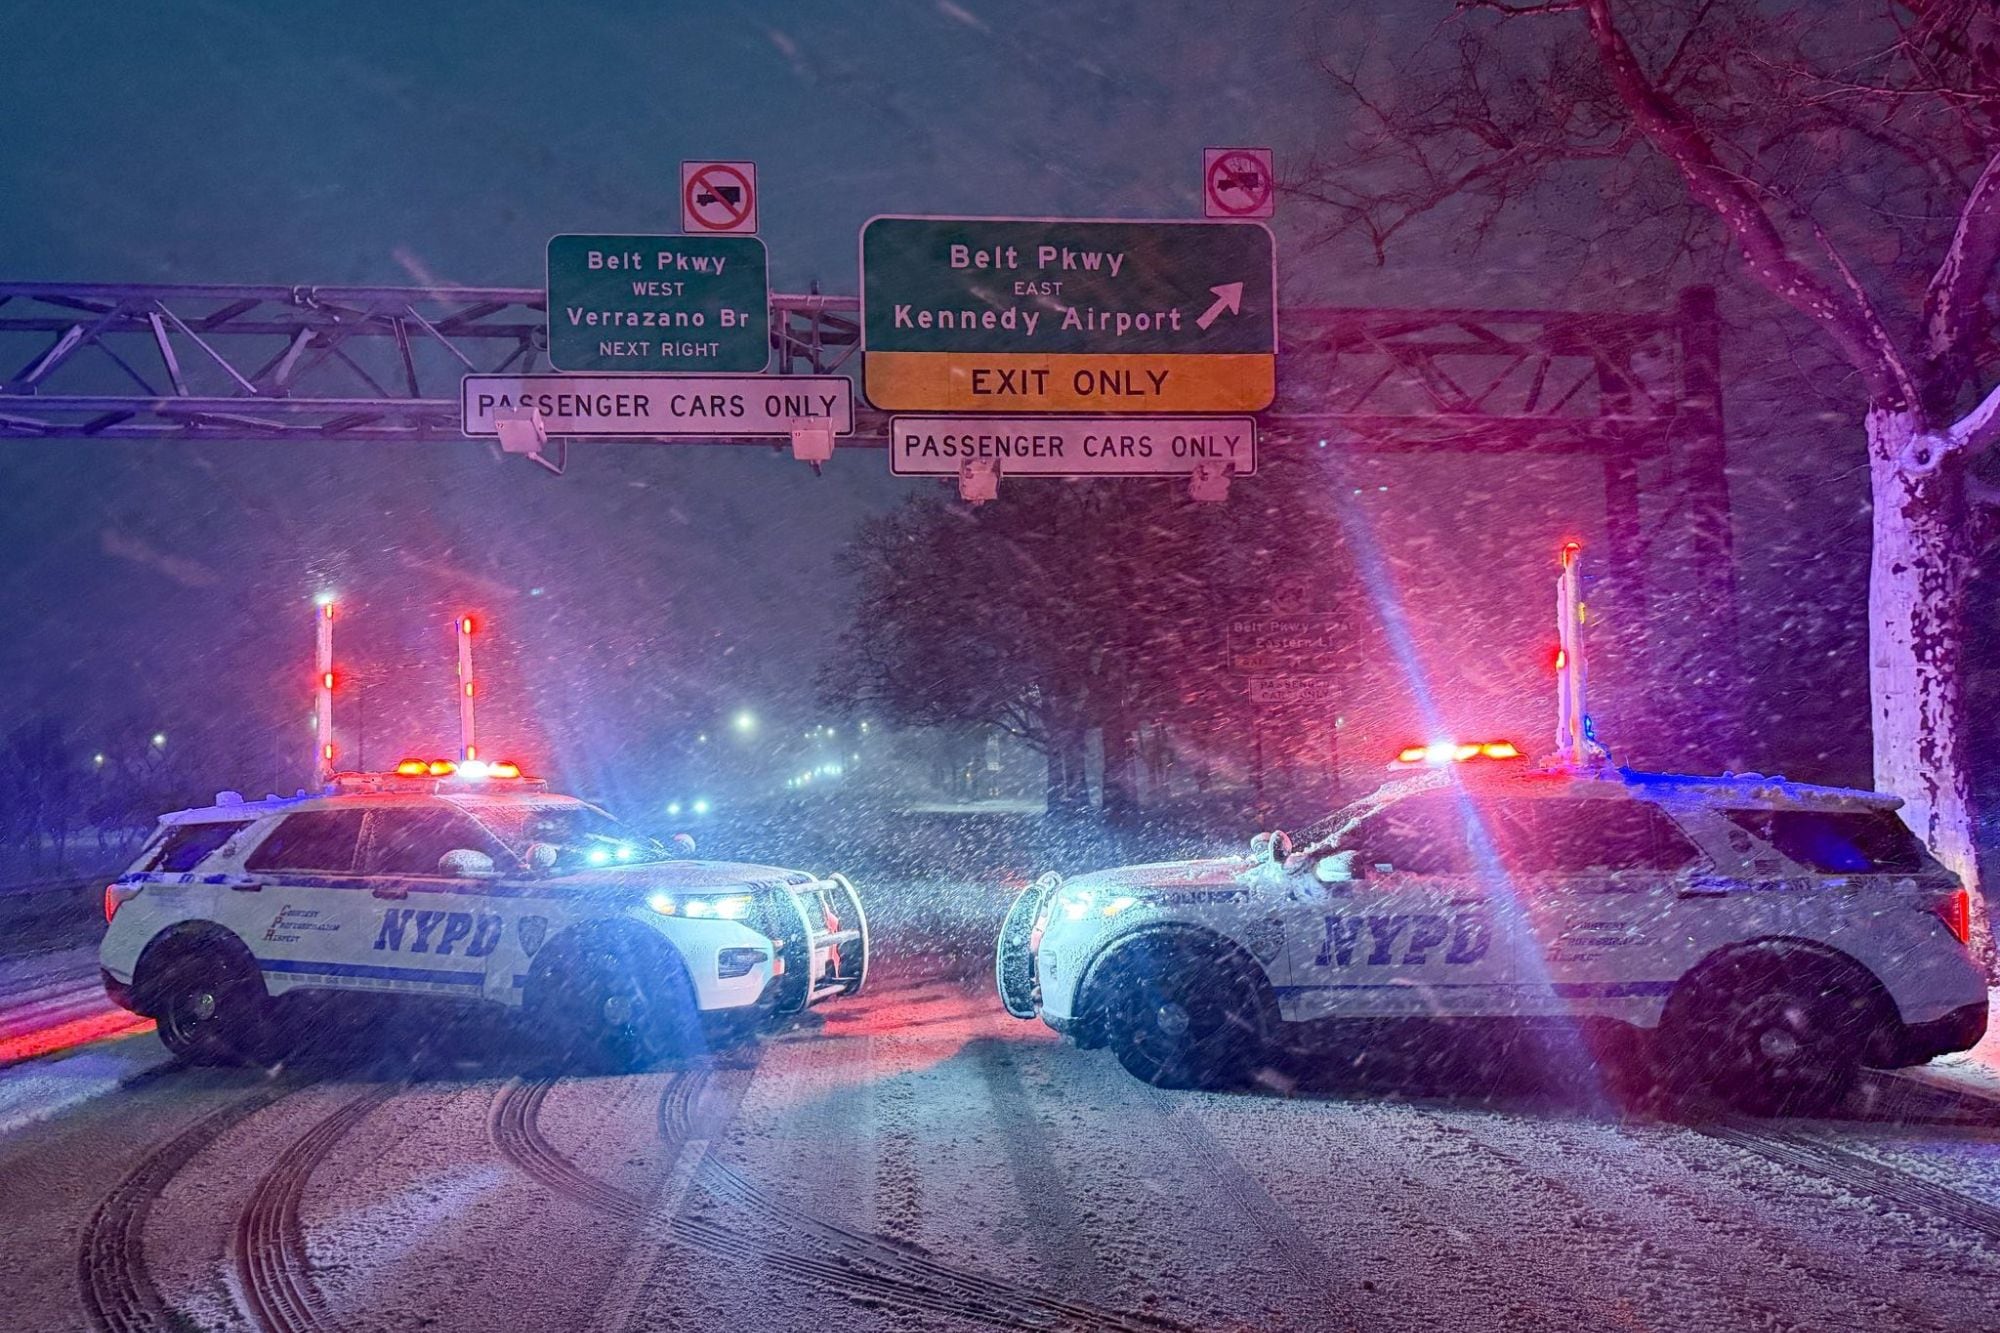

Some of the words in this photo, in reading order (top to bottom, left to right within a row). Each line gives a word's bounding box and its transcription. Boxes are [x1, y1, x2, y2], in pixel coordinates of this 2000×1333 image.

[587, 252, 642, 271] Belt
[658, 252, 726, 275] Pkwy
[950, 245, 1018, 269] Belt
[1038, 246, 1125, 277] Pkwy
[632, 282, 684, 297] WEST
[1014, 281, 1064, 296] EAST
[567, 308, 705, 327] Verrazano
[720, 309, 749, 328] Br
[894, 305, 1040, 335] Kennedy
[1061, 307, 1182, 335] Airport
[599, 341, 650, 357] NEXT
[661, 342, 720, 358] RIGHT
[971, 369, 1050, 396] EXIT
[1073, 370, 1169, 396] ONLY
[478, 394, 649, 418] PASSENGER
[670, 395, 744, 418] CARS
[765, 395, 837, 417] ONLY
[905, 434, 1063, 458] PASSENGER
[1083, 435, 1152, 458] CARS
[1172, 435, 1241, 458] ONLY
[373, 908, 501, 957] NYPD
[1315, 914, 1492, 967] NYPD
